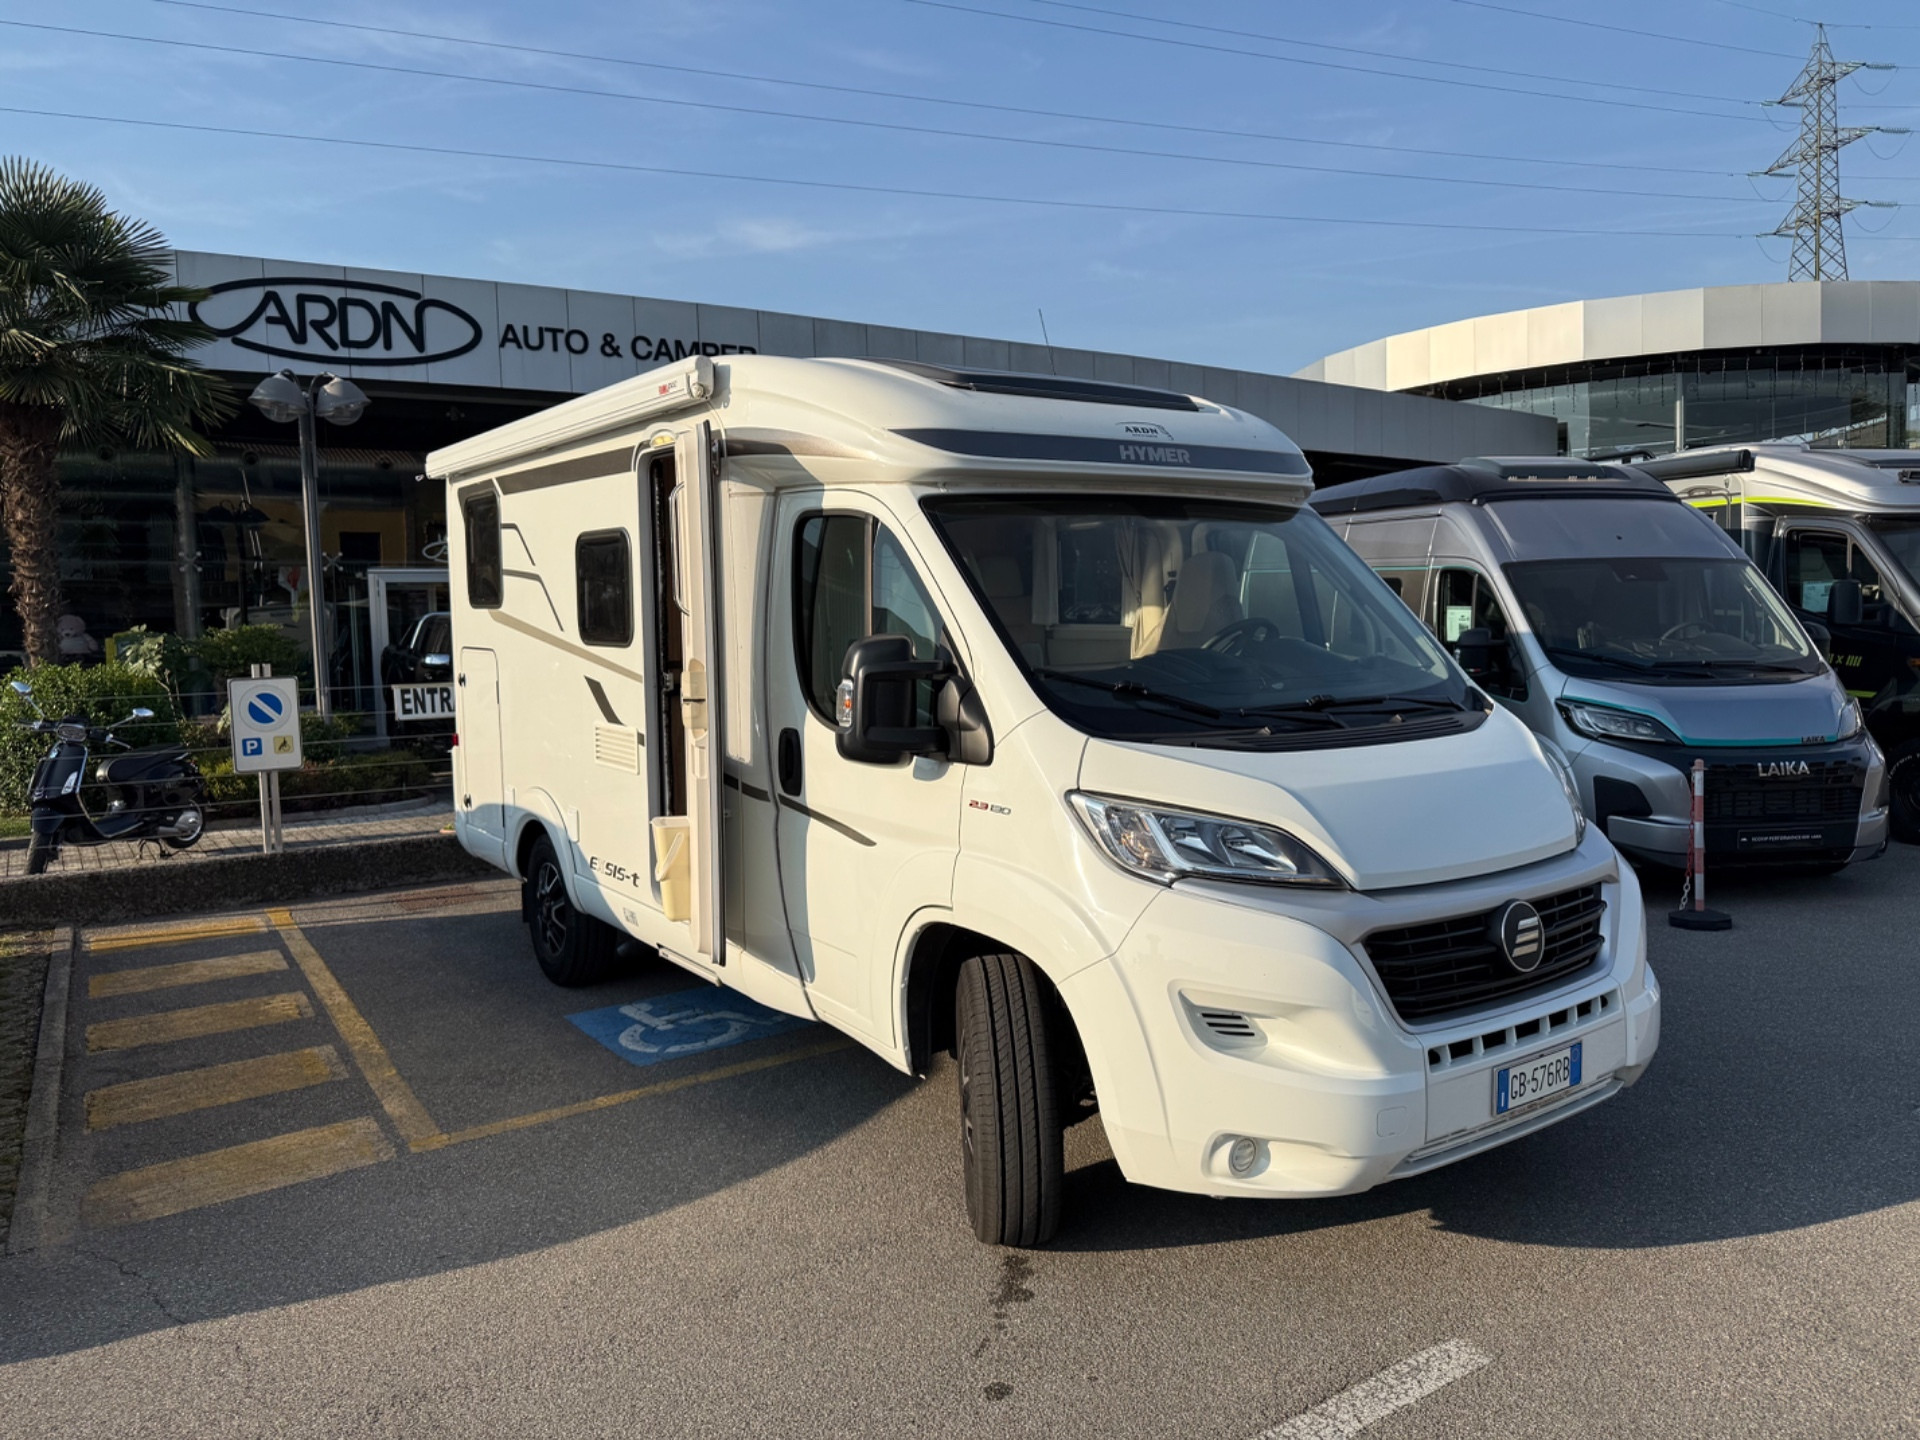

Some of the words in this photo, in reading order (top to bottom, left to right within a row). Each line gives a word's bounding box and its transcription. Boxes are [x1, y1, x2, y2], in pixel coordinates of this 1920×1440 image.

[238, 286, 438, 356] ARDN
[499, 323, 590, 355] AUTO
[600, 332, 623, 359] &
[1125, 426, 1159, 434] ARDN
[1120, 445, 1190, 464] HYMER
[400, 687, 457, 715] ENTR
[246, 740, 259, 754] P
[1757, 761, 1810, 776] LAIKA
